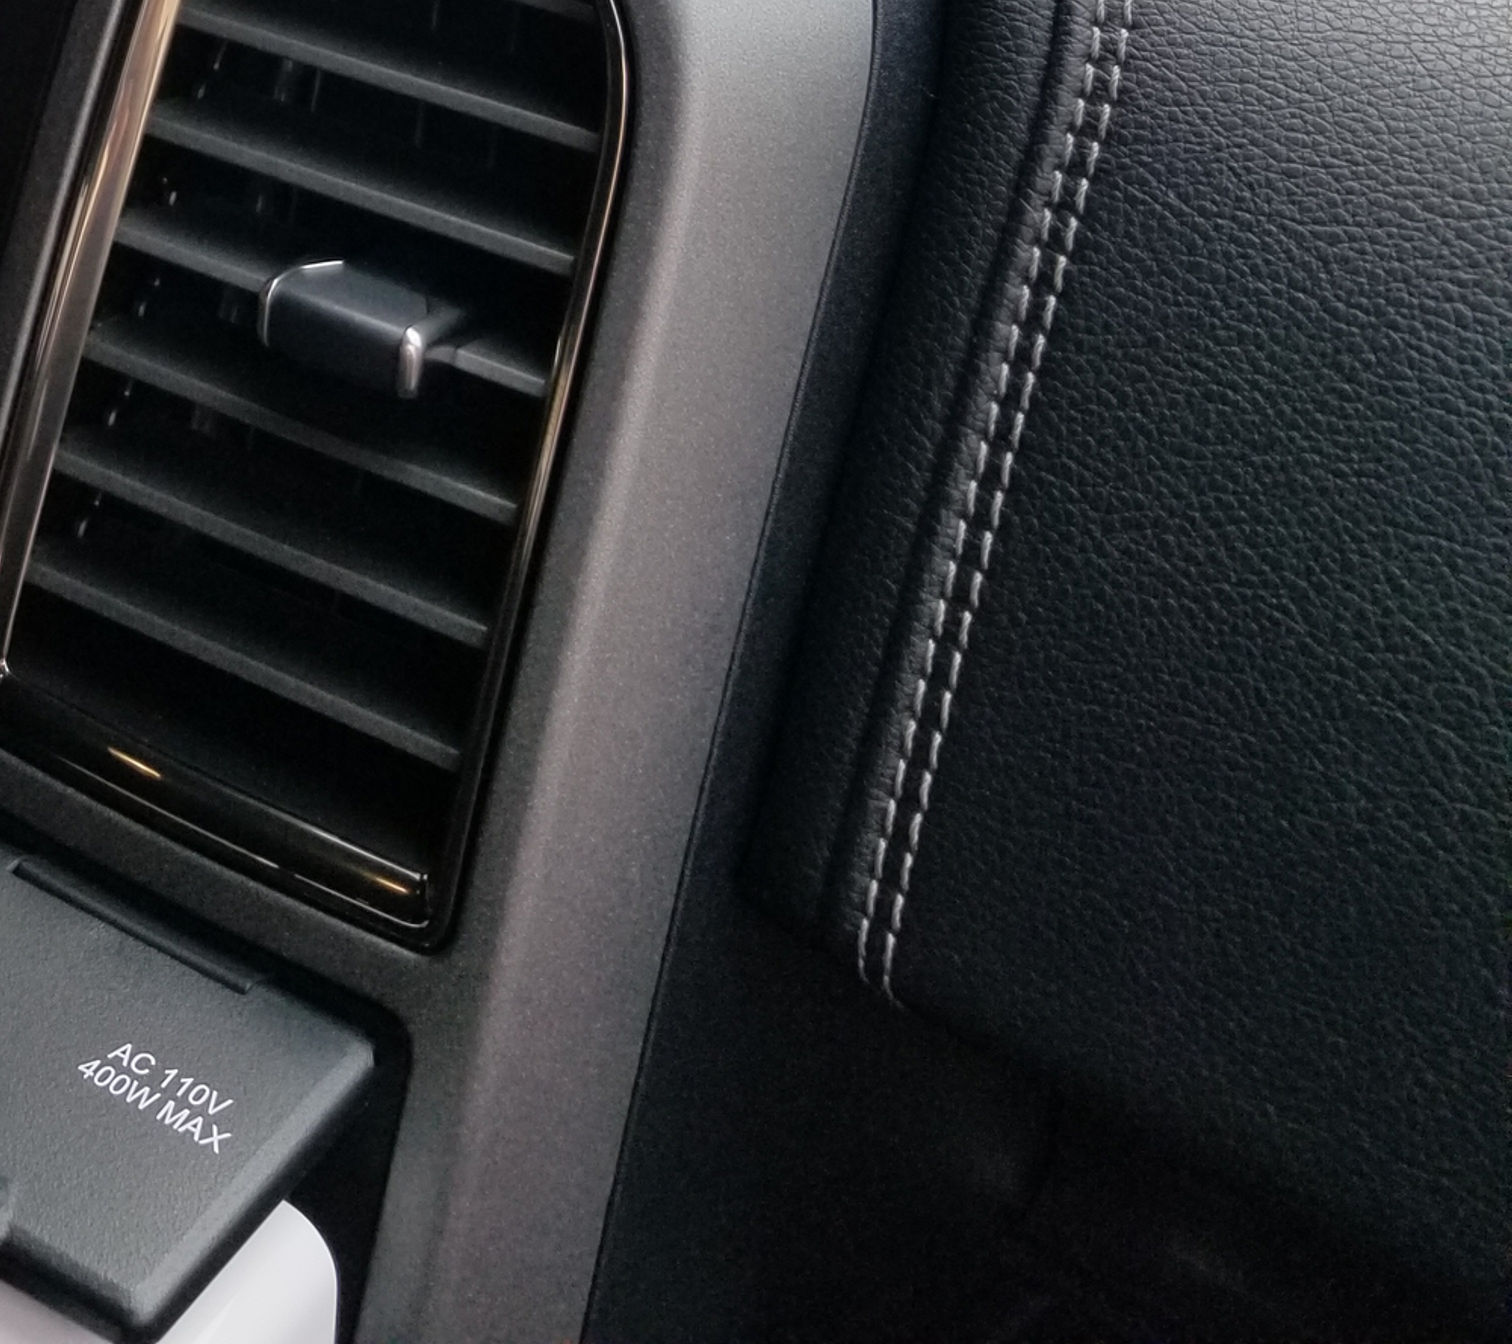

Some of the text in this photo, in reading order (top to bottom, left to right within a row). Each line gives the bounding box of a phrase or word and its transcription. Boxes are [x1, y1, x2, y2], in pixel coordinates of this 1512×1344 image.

[76, 1057, 233, 1154] 400W MAX
[106, 1041, 235, 1117] AC 110V
